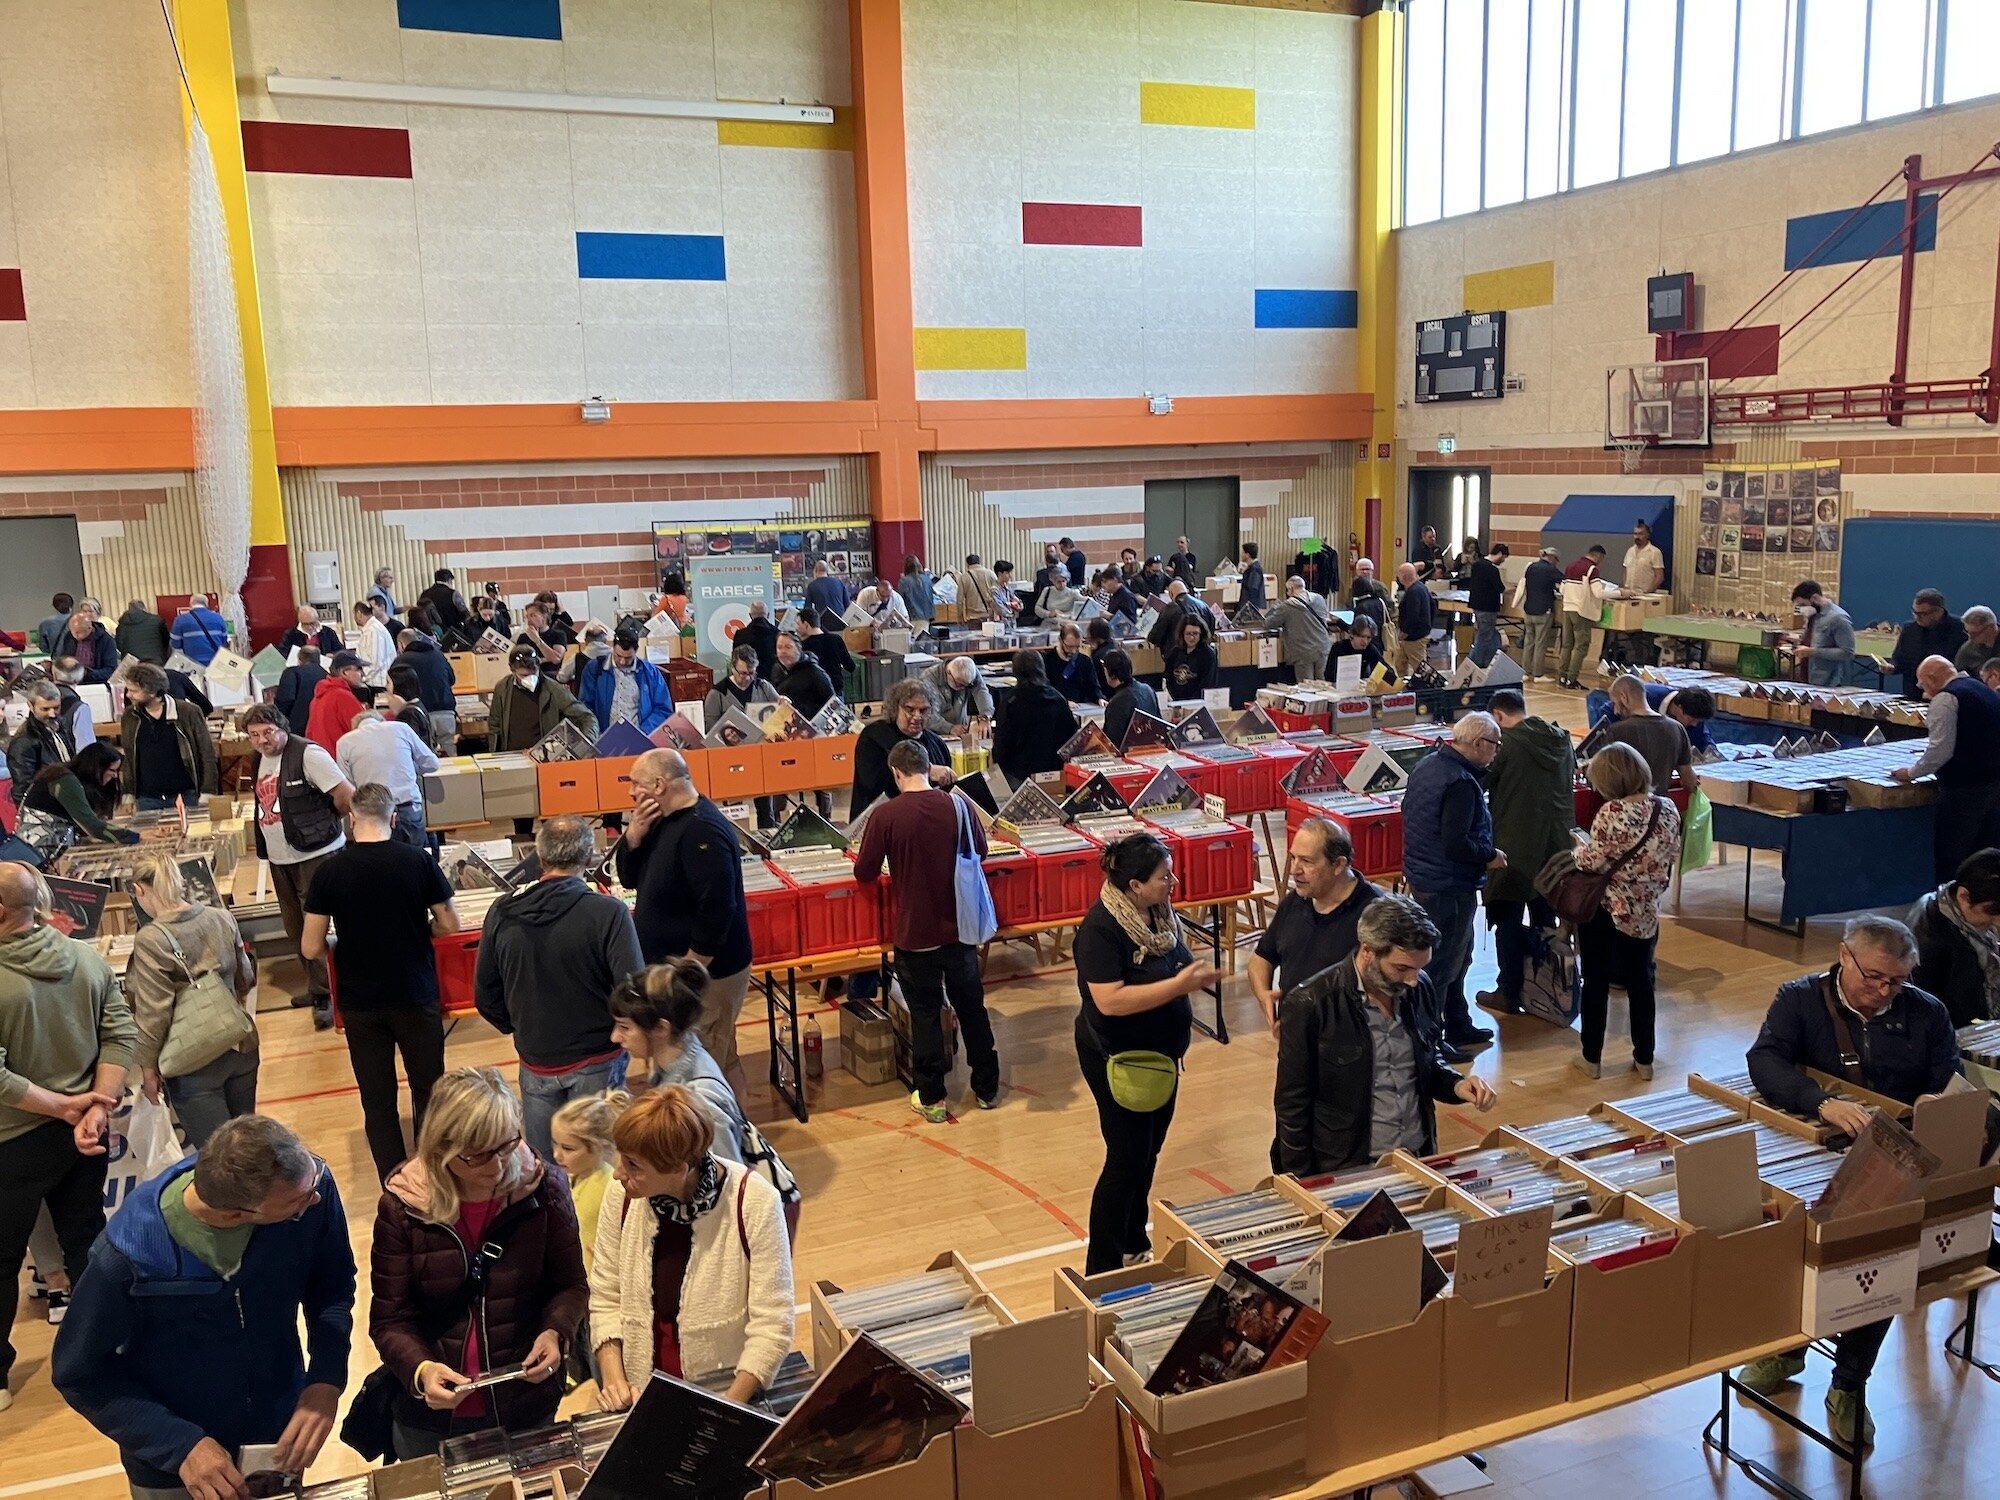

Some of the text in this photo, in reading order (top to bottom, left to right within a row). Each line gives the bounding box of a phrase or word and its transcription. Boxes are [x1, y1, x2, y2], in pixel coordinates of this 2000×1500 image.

[1424, 320, 1443, 332] LOCALI
[1471, 314, 1492, 326] OSPITI
[699, 565, 763, 574] www.rarecs.at
[701, 585, 764, 597] RARECS
